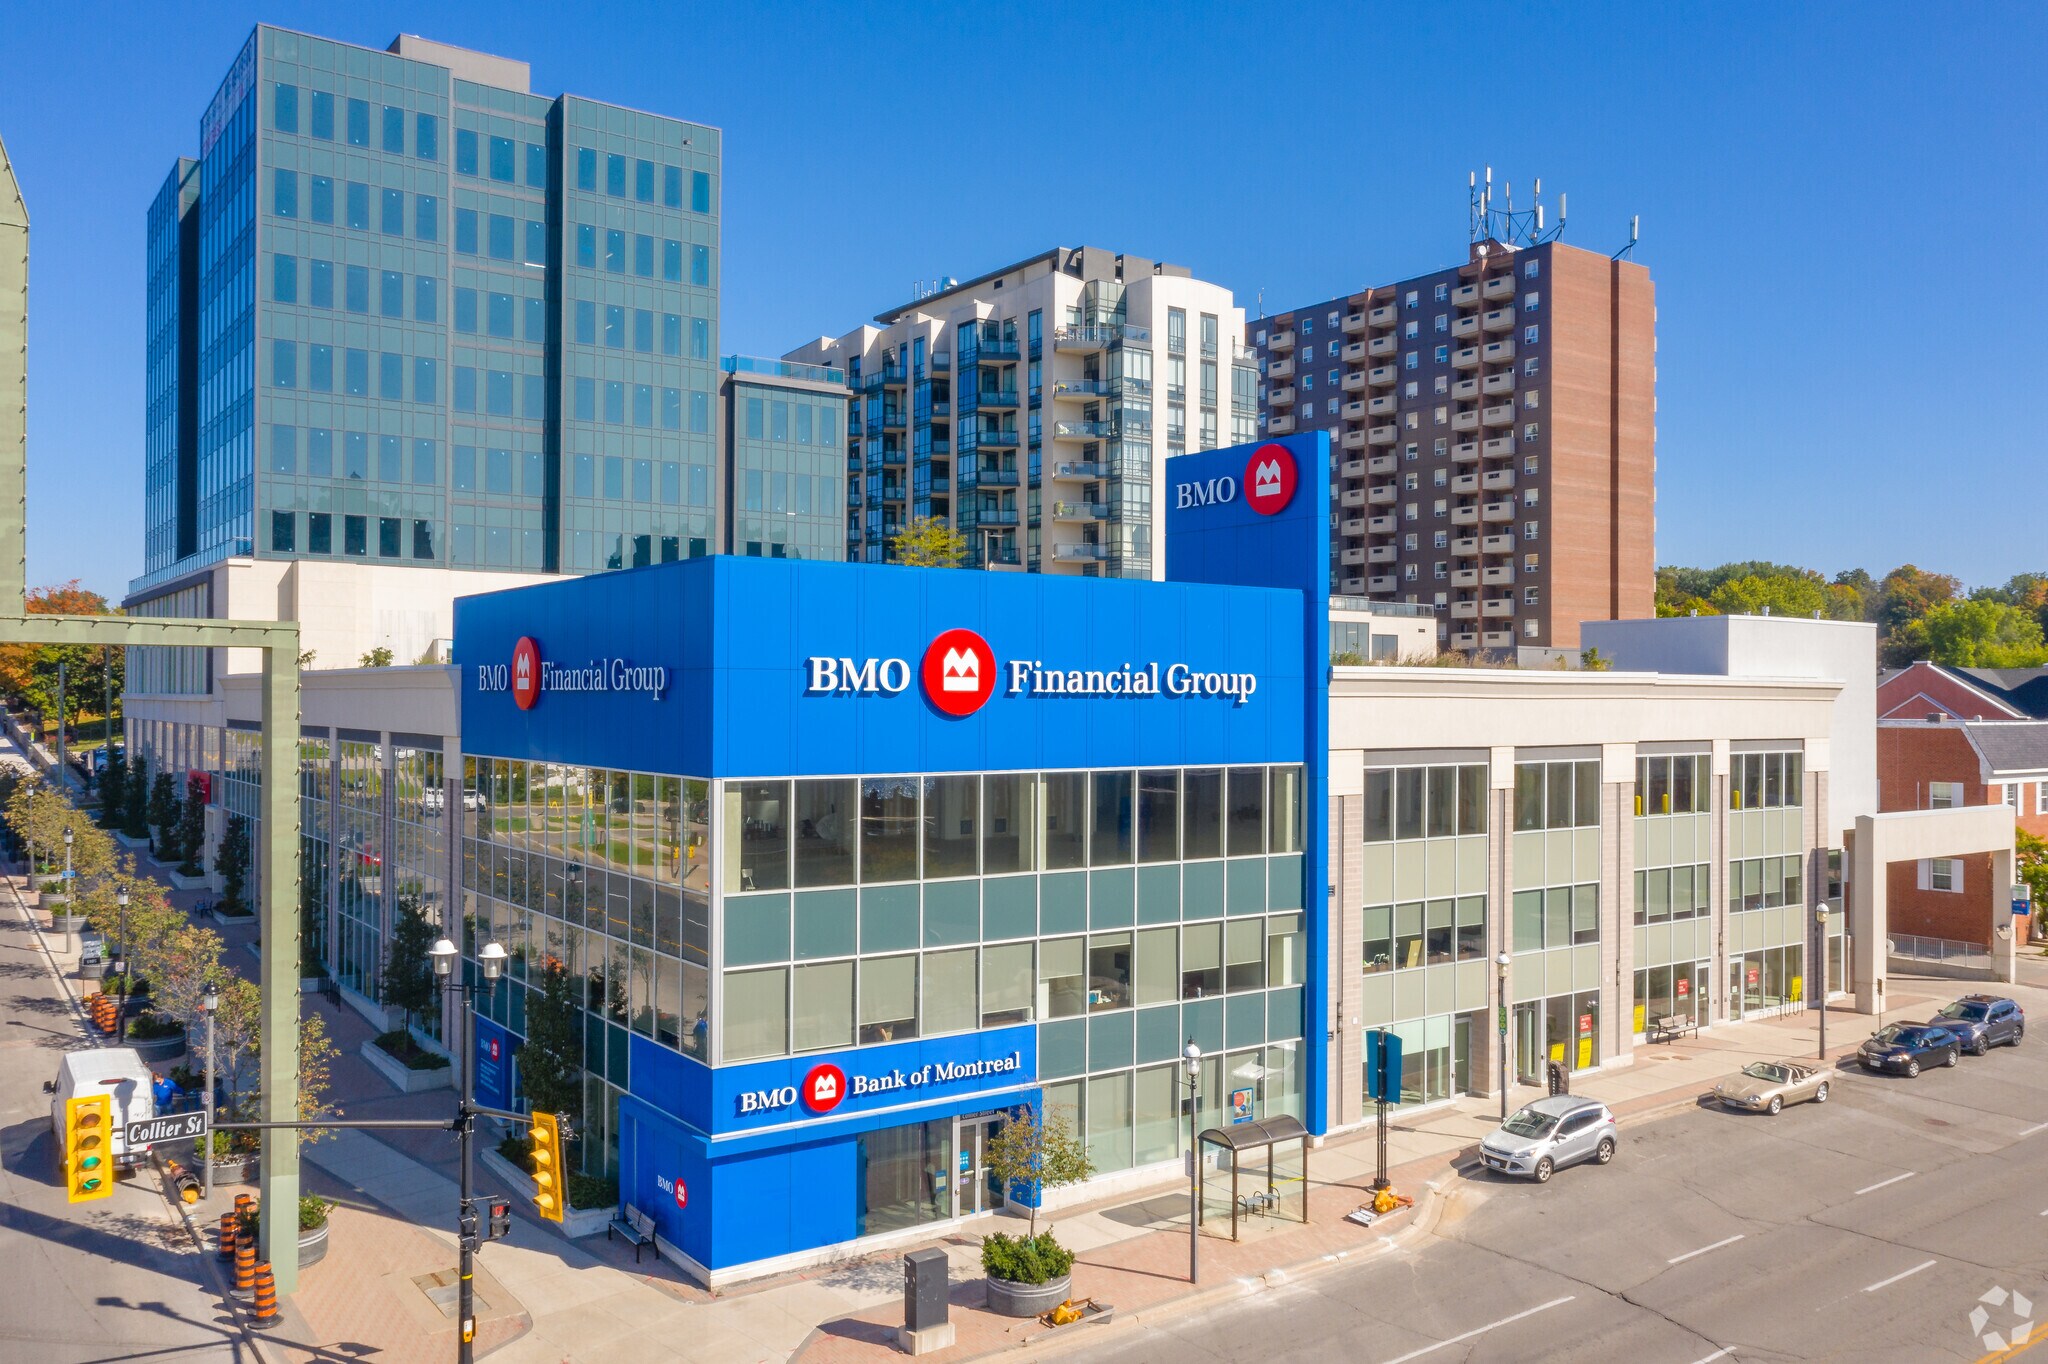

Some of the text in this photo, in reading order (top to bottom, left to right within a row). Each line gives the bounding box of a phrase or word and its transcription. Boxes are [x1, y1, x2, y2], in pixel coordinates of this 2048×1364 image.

[1176, 476, 1236, 509] BMO
[478, 658, 665, 700] BMO Financial Group
[809, 656, 1257, 704] BMO Financial Group
[741, 1052, 1021, 1112] BMO Bank of Montreal
[130, 1116, 202, 1142] Collier St
[658, 1175, 673, 1194] BMO
